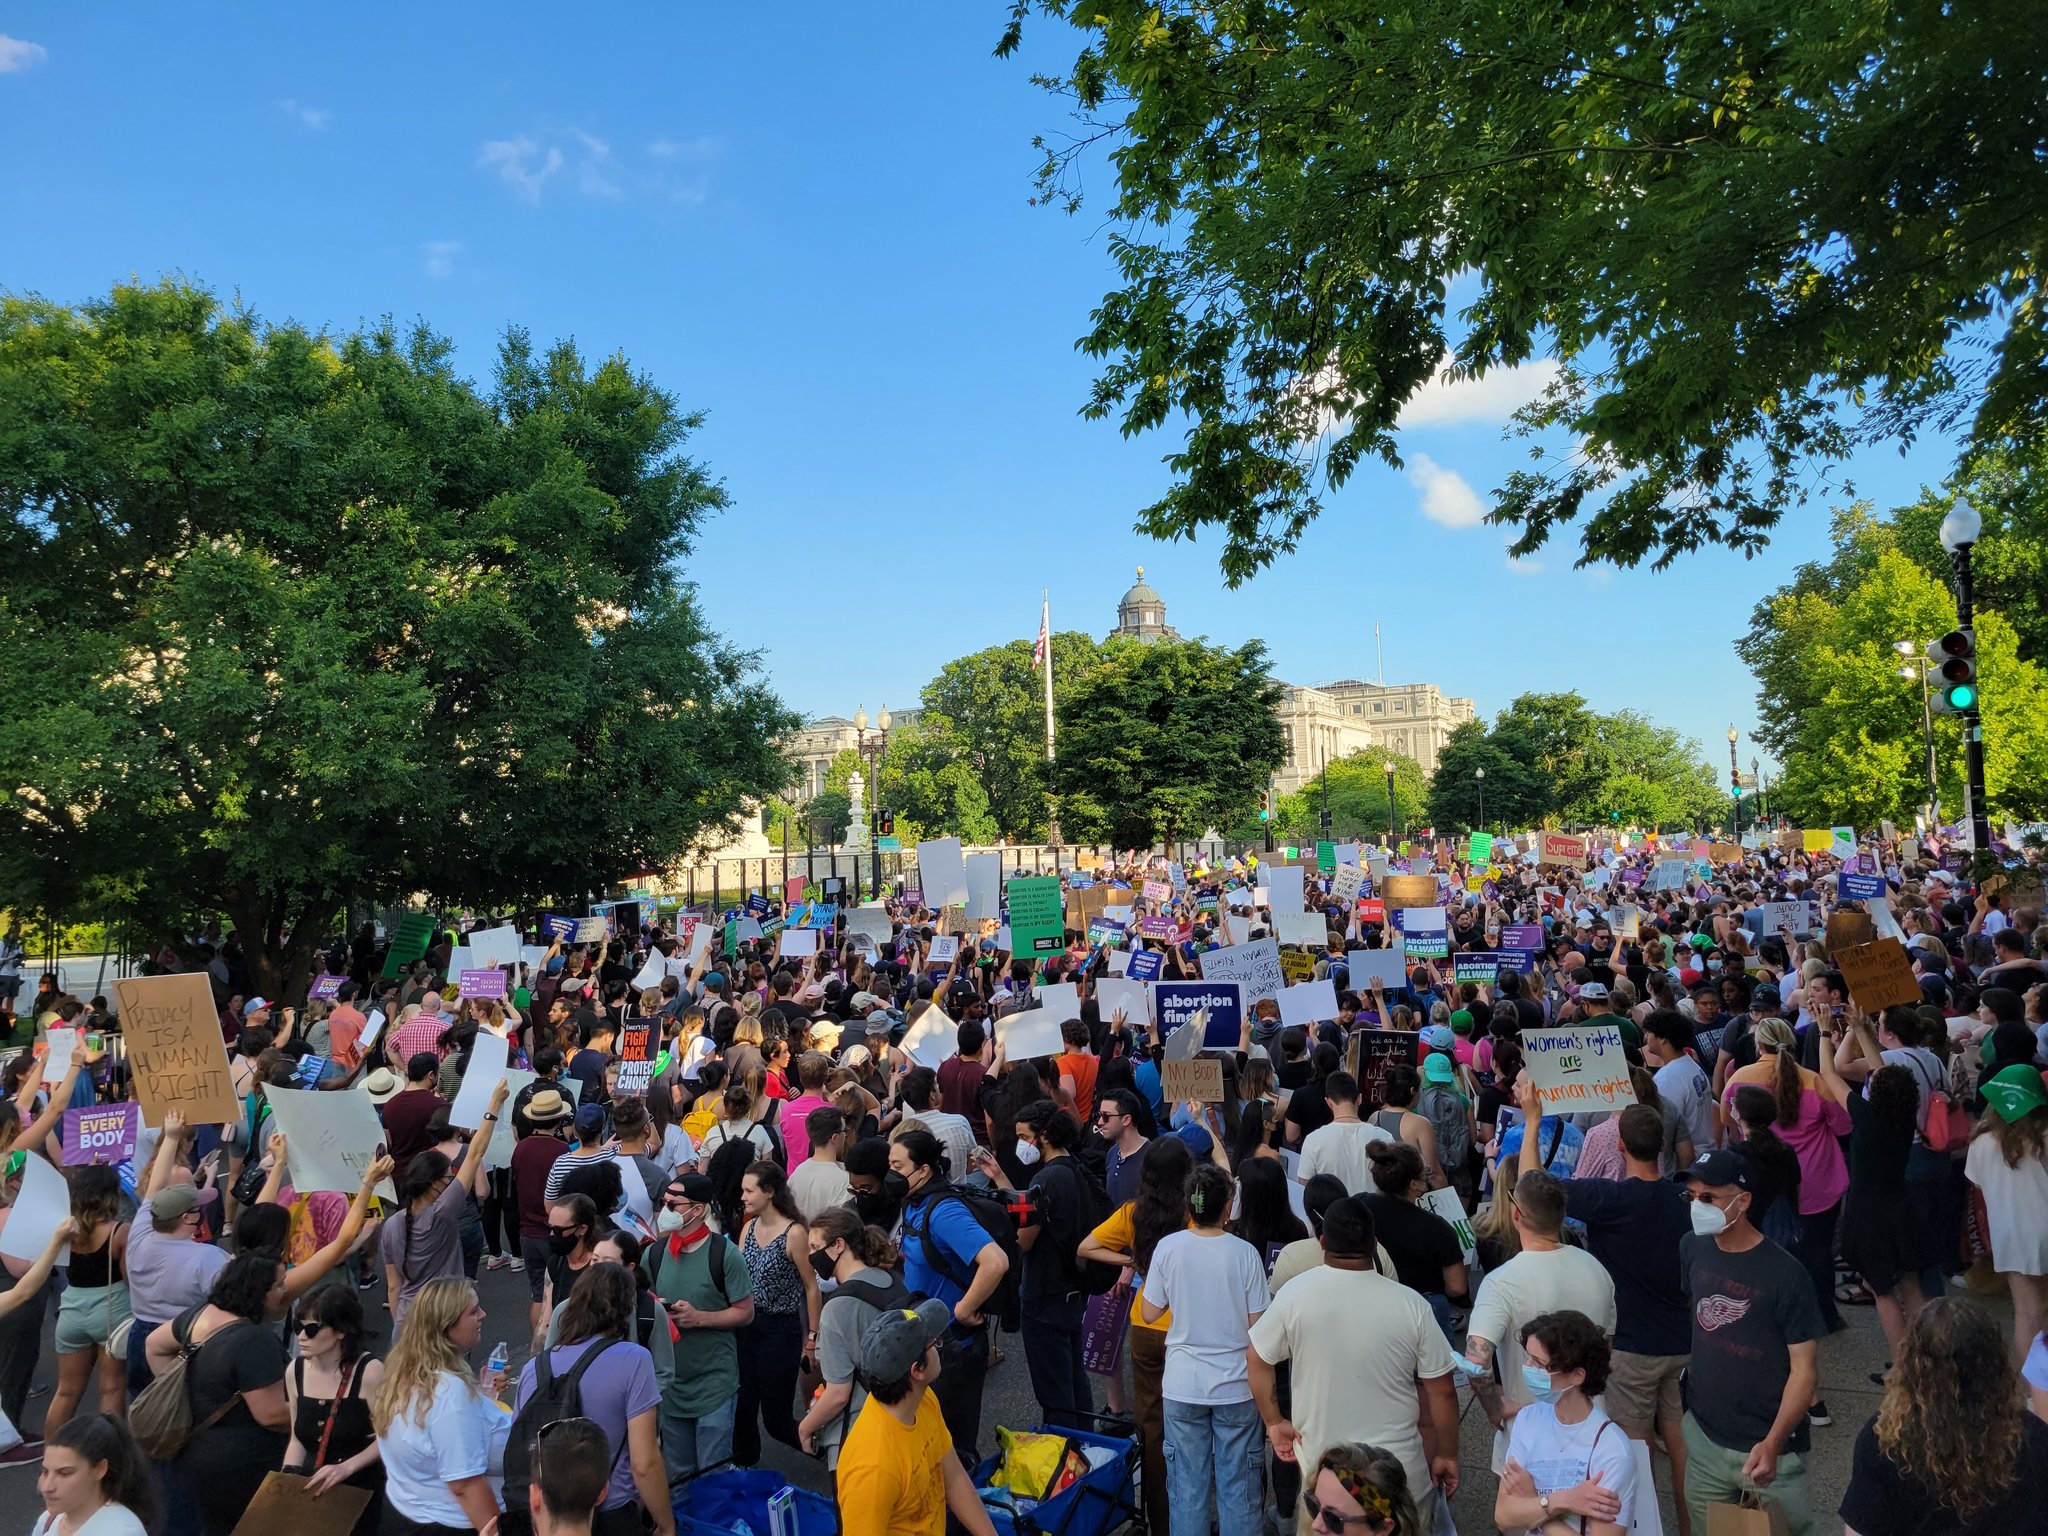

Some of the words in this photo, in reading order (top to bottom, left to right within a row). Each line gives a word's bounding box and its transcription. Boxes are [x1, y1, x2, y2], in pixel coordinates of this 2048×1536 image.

[1546, 836, 1583, 856] Supreme
[1342, 868, 1361, 878] WHEN
[1774, 903, 1801, 914] COURT
[1780, 913, 1797, 921] THE
[684, 921, 697, 933] RO
[1242, 946, 1270, 962] HUMAN
[1406, 944, 1447, 953] ALWAYS
[1203, 955, 1235, 971] RIGHTS
[1457, 962, 1497, 970] ABORTION
[1458, 970, 1496, 979] ALWAYS
[117, 982, 193, 1030] PRIVACY
[1163, 993, 1233, 1008] abortion
[147, 1027, 177, 1048] IS
[181, 1025, 194, 1043] A
[624, 1031, 650, 1046] FIGHT
[1370, 1036, 1382, 1044] We
[1395, 1035, 1409, 1045] the
[1586, 1028, 1621, 1056] rights
[622, 1046, 648, 1060] BACK.
[1371, 1045, 1407, 1058] Daughters
[133, 1044, 209, 1076] HUMAN
[620, 1060, 656, 1075] PROTECT
[1559, 1055, 1582, 1069] are
[1168, 1063, 1187, 1081] MY
[1193, 1061, 1218, 1080] BODY
[147, 1070, 223, 1103] RIGHT
[617, 1075, 650, 1090] CHOICE
[1533, 1081, 1591, 1102] human
[1592, 1075, 1633, 1104] rights
[1167, 1084, 1188, 1100] MY
[1189, 1083, 1220, 1099] CHOICE
[80, 1112, 107, 1120] FREEDOM
[80, 1116, 126, 1134] EVERY
[80, 1130, 126, 1149] BODY
[1085, 1331, 1095, 1349] are
[1104, 1340, 1112, 1352] 10
[1089, 1351, 1099, 1369] the
[1100, 1354, 1109, 1362] in
